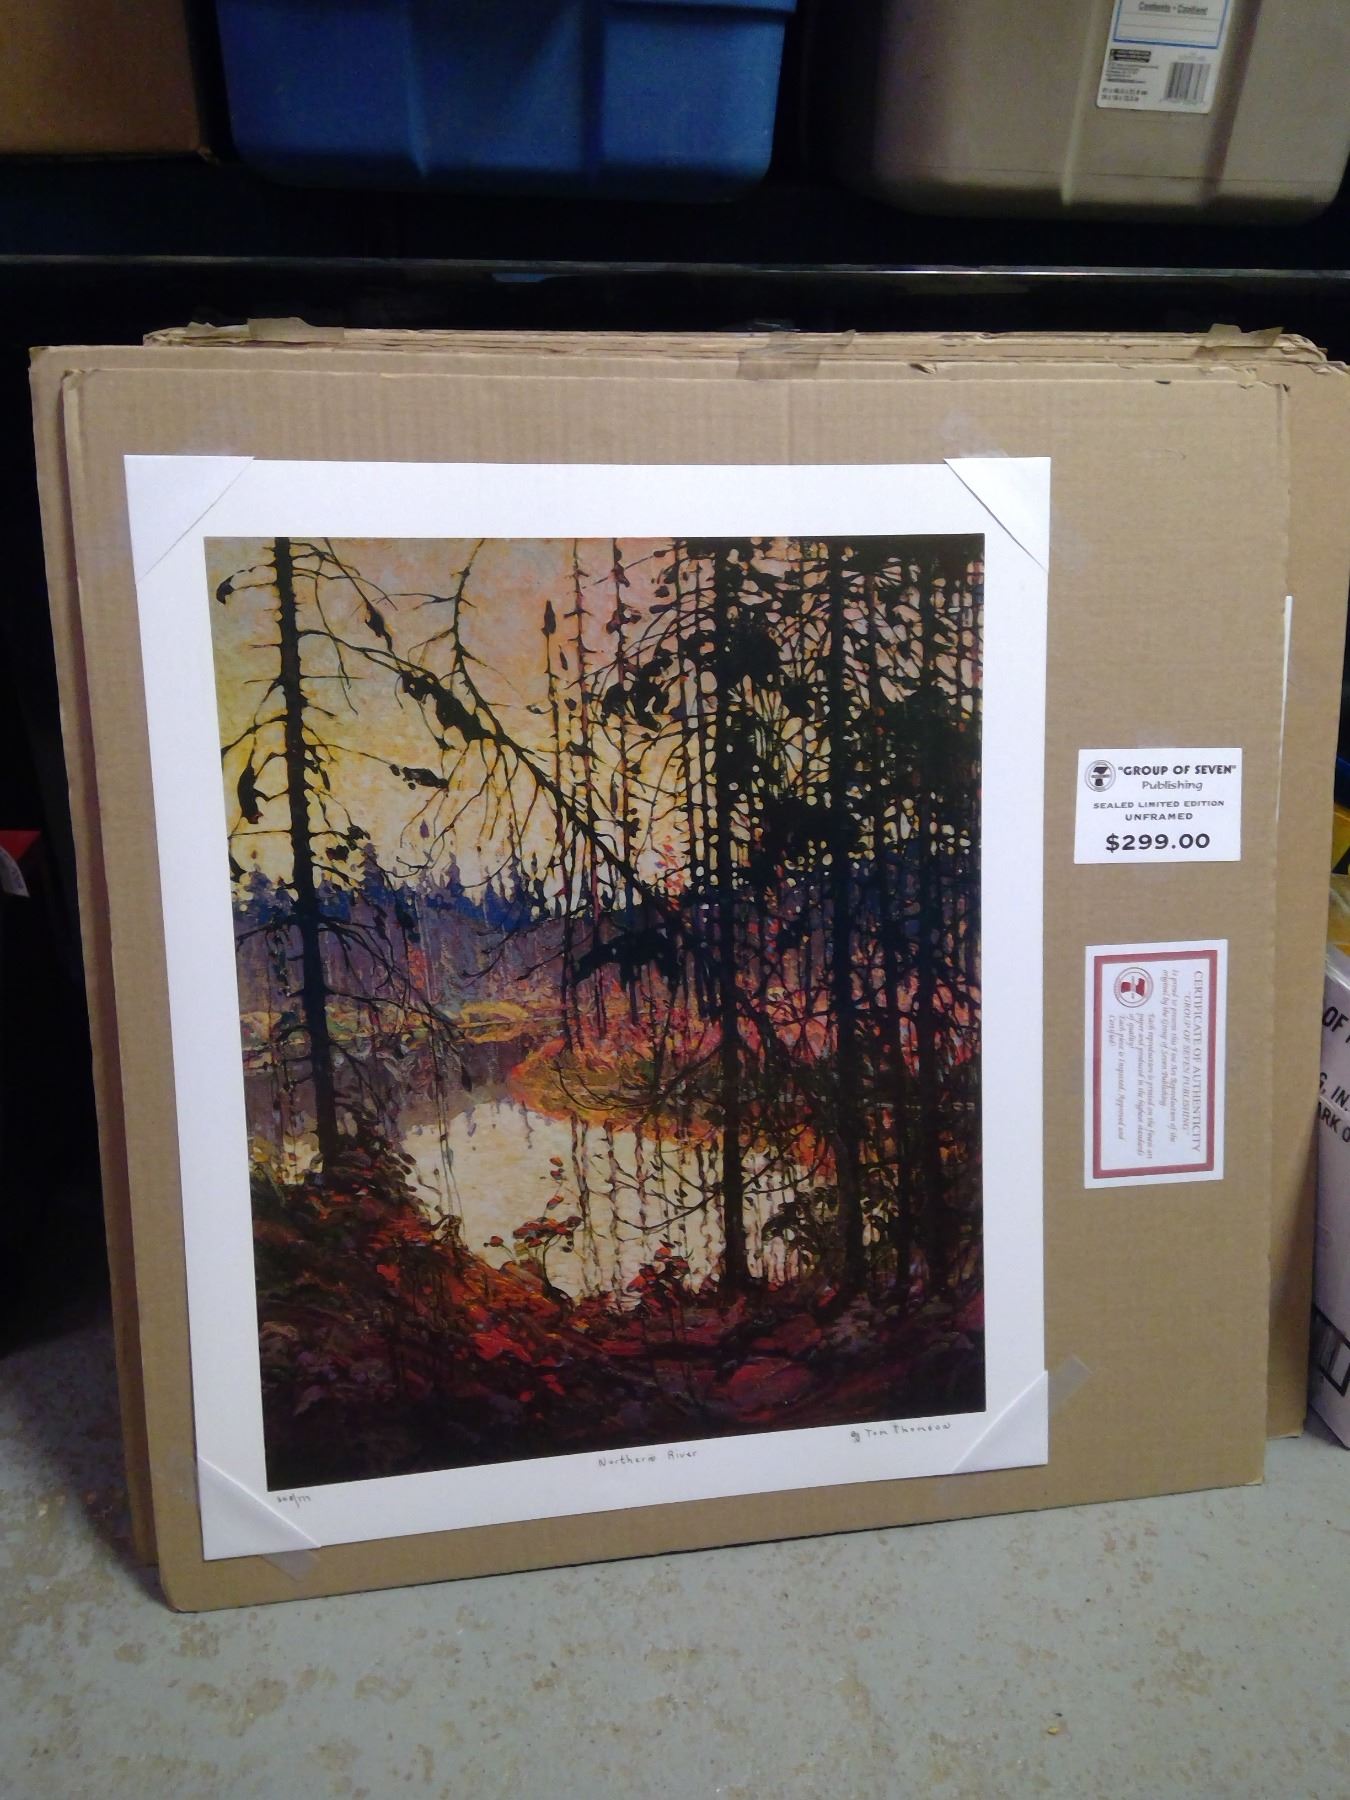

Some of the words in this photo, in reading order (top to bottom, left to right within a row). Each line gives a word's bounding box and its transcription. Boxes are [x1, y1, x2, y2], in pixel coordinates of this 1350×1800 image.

[1118, 765, 1169, 776] "GROUP
[1172, 765, 1190, 775] OF
[1194, 764, 1237, 775] SEVEN"
[1141, 780, 1203, 791] Publishing
[1093, 801, 1134, 809] SEALED
[1125, 812, 1193, 821] UNFRAMED
[1105, 833, 1210, 853] $299.00
[1194, 971, 1203, 1044] CERTIFICATE
[1193, 1048, 1202, 1063] OF
[1192, 1066, 1201, 1152] AUTHENTICITY
